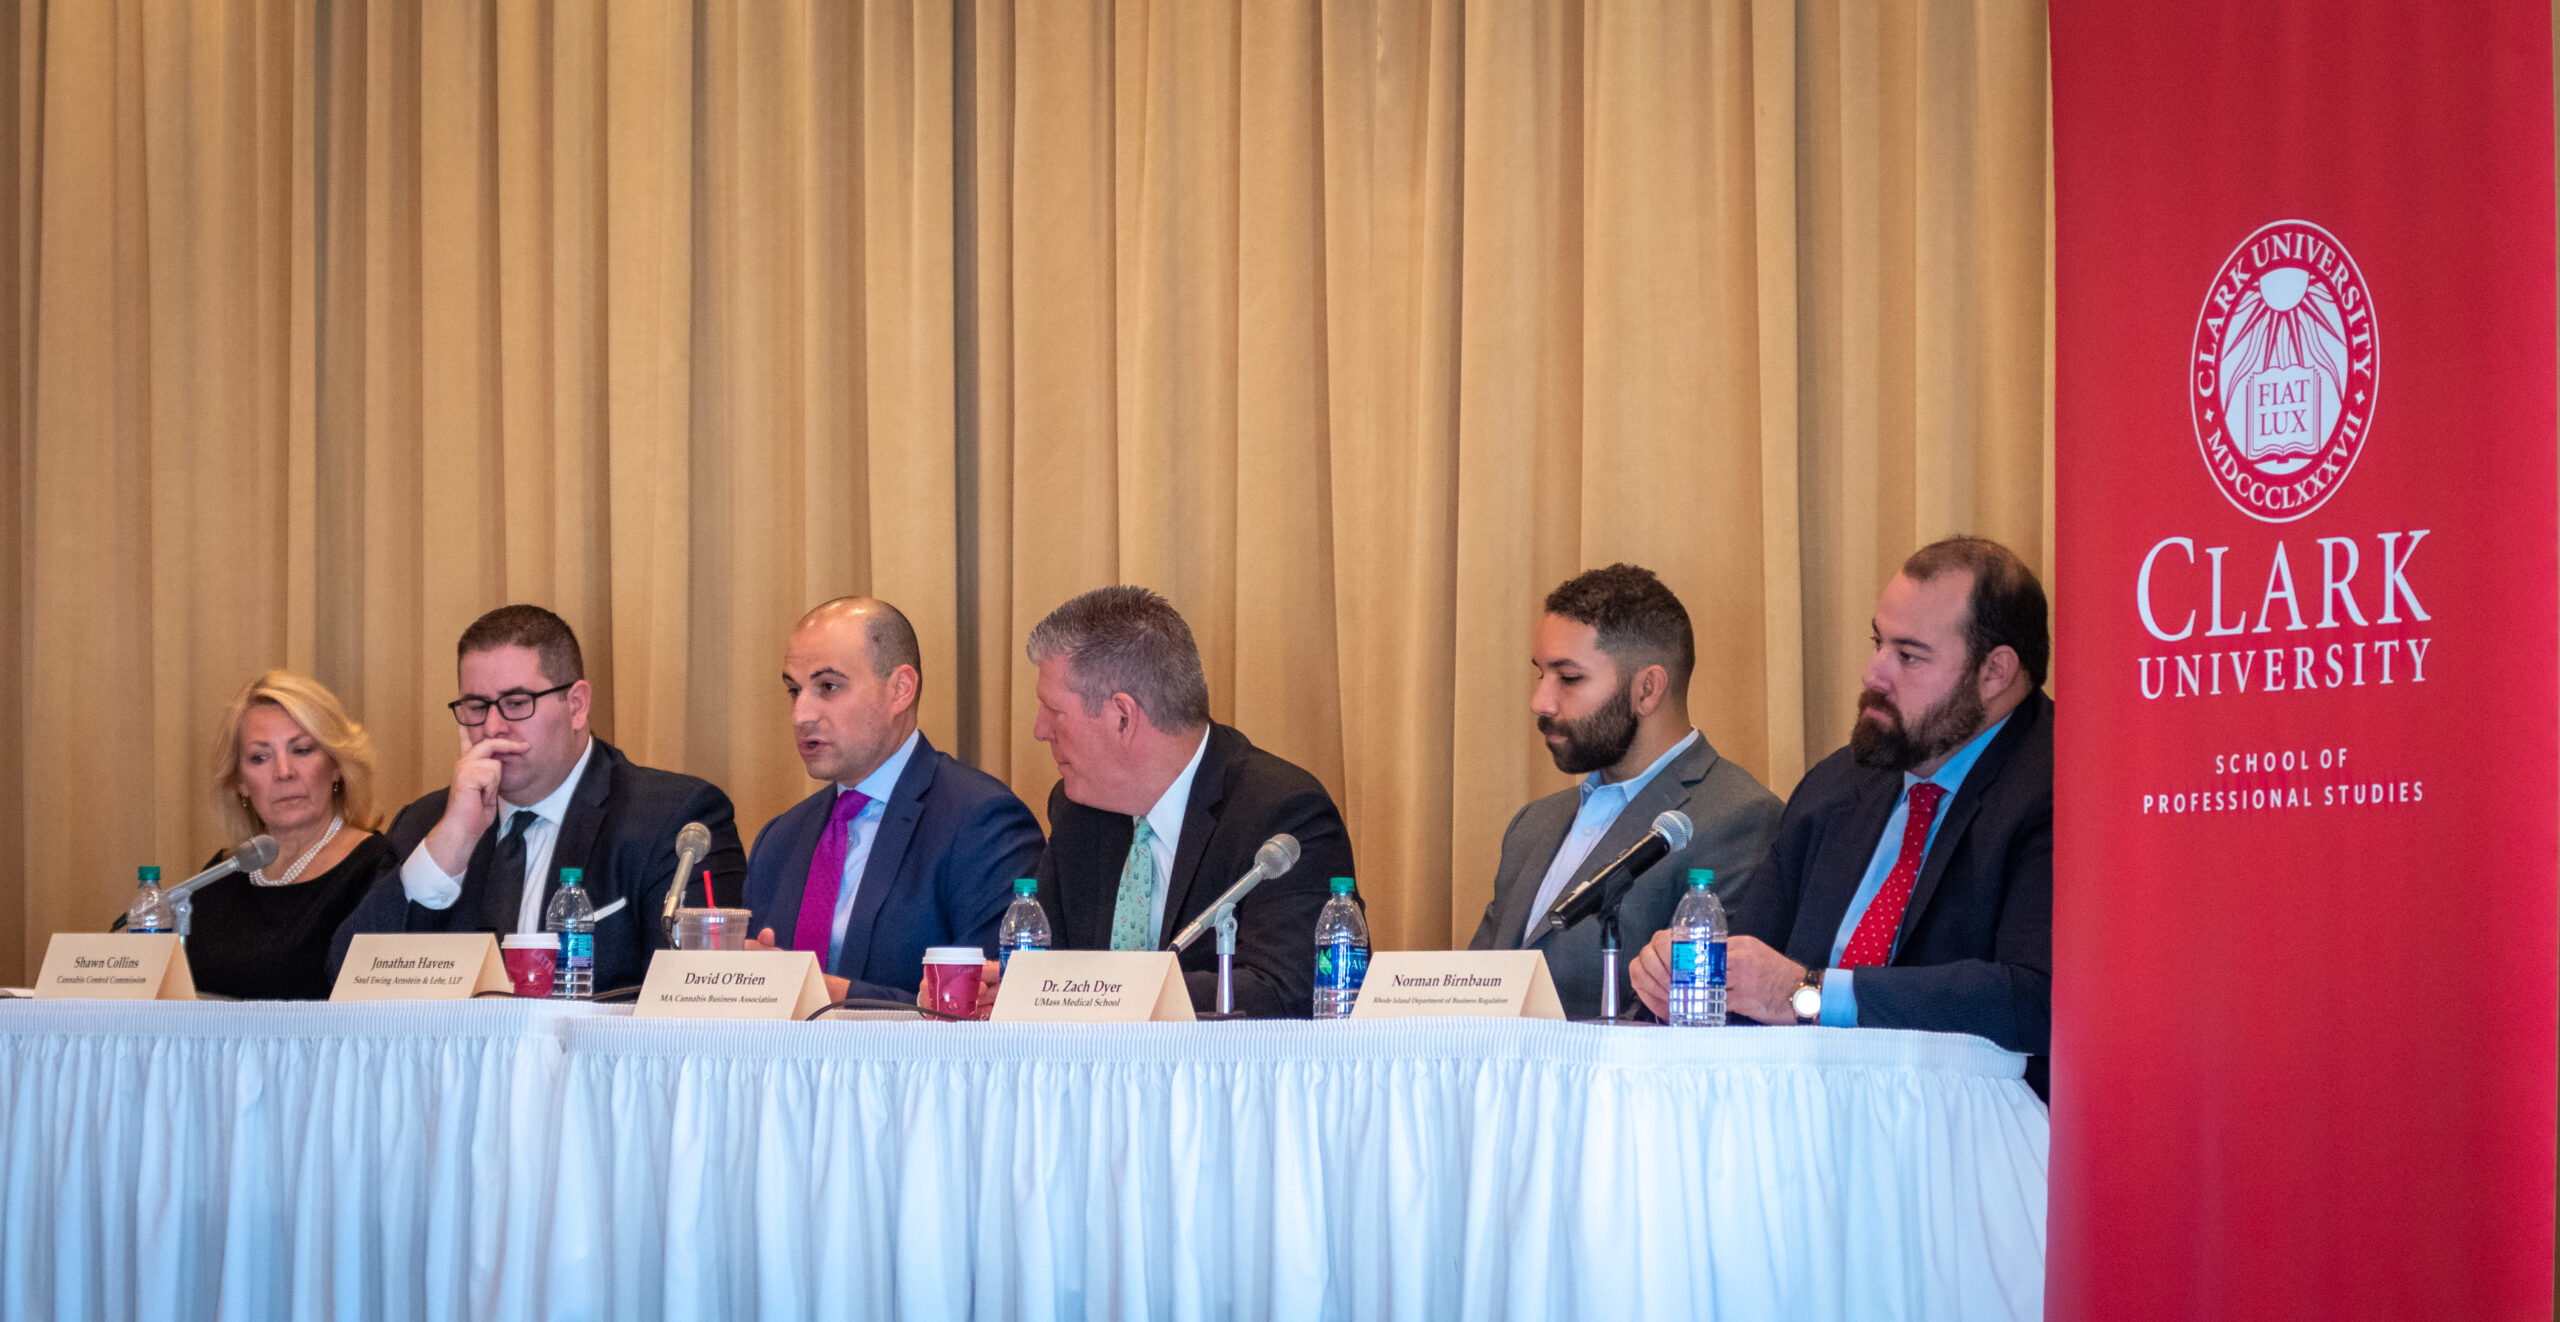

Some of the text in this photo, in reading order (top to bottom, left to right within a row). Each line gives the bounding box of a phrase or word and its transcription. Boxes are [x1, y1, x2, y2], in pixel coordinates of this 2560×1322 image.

[2198, 232, 2372, 397] CLARK UNIVERSITY
[2258, 379, 2310, 407] FIAT
[2259, 409, 2308, 436] LUX
[2207, 412, 2362, 510] MDCCCLXXXVII
[2137, 529, 2431, 642] CLARK
[2138, 638, 2431, 700] UNIVERSITY
[2216, 748, 2347, 774] SCHOOL OF
[2143, 781, 2423, 814] PROFESSIONAL STUDIES
[73, 956, 139, 969] Shawn Collins
[370, 957, 455, 971] Jonathan Havens
[56, 975, 146, 984] Cannabis Control Commission
[353, 976, 462, 987] Saul Ewing Arnstein & Lehr, LLP
[684, 972, 766, 985] David O'Brien
[1392, 974, 1502, 987] Norman Birnbaum
[1042, 980, 1123, 996] Dr. Zach Dyer
[660, 994, 778, 1003] MA Cannabis Business Association
[1034, 998, 1121, 1007] UMass Medical School
[1411, 997, 1443, 1005] Department
[1478, 997, 1508, 1005] Regulation
